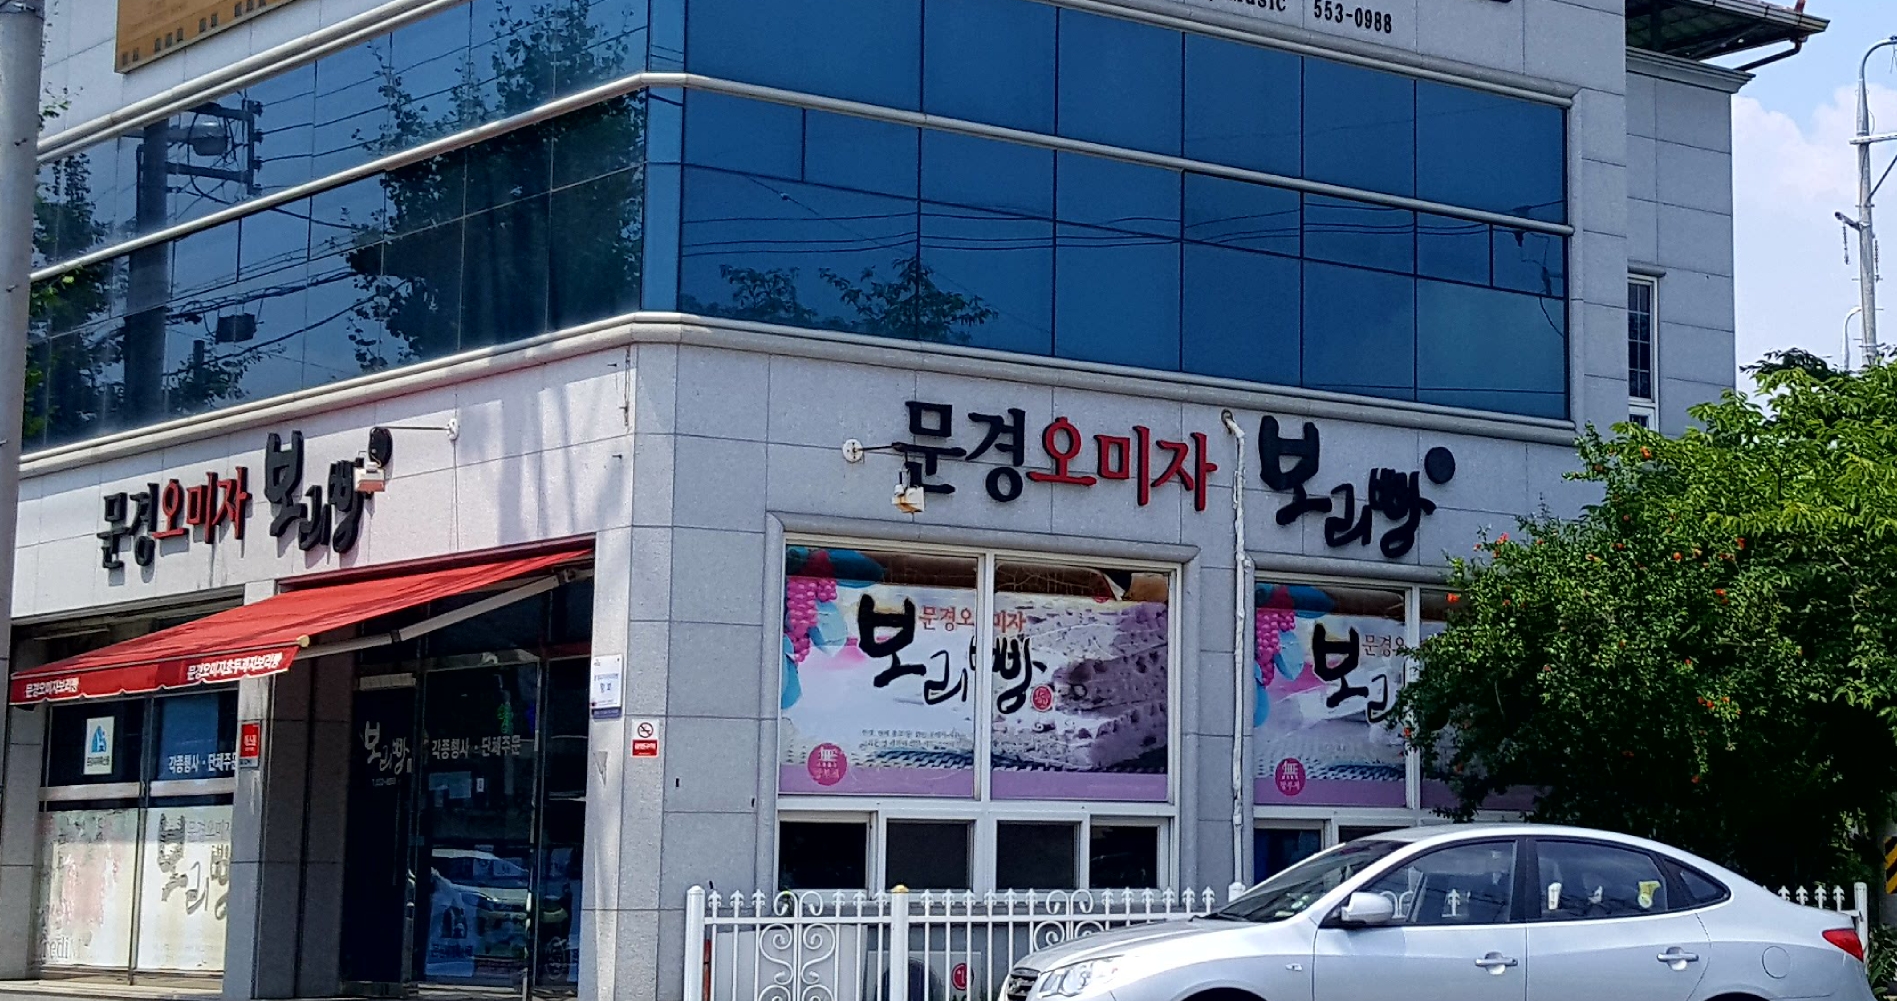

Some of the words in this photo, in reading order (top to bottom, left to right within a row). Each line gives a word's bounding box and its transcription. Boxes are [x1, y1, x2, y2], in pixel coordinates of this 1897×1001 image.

[97, 466, 252, 568] 문경오미자
[893, 400, 1217, 511] 문경오미자
[1259, 415, 1437, 558] 보리빵
